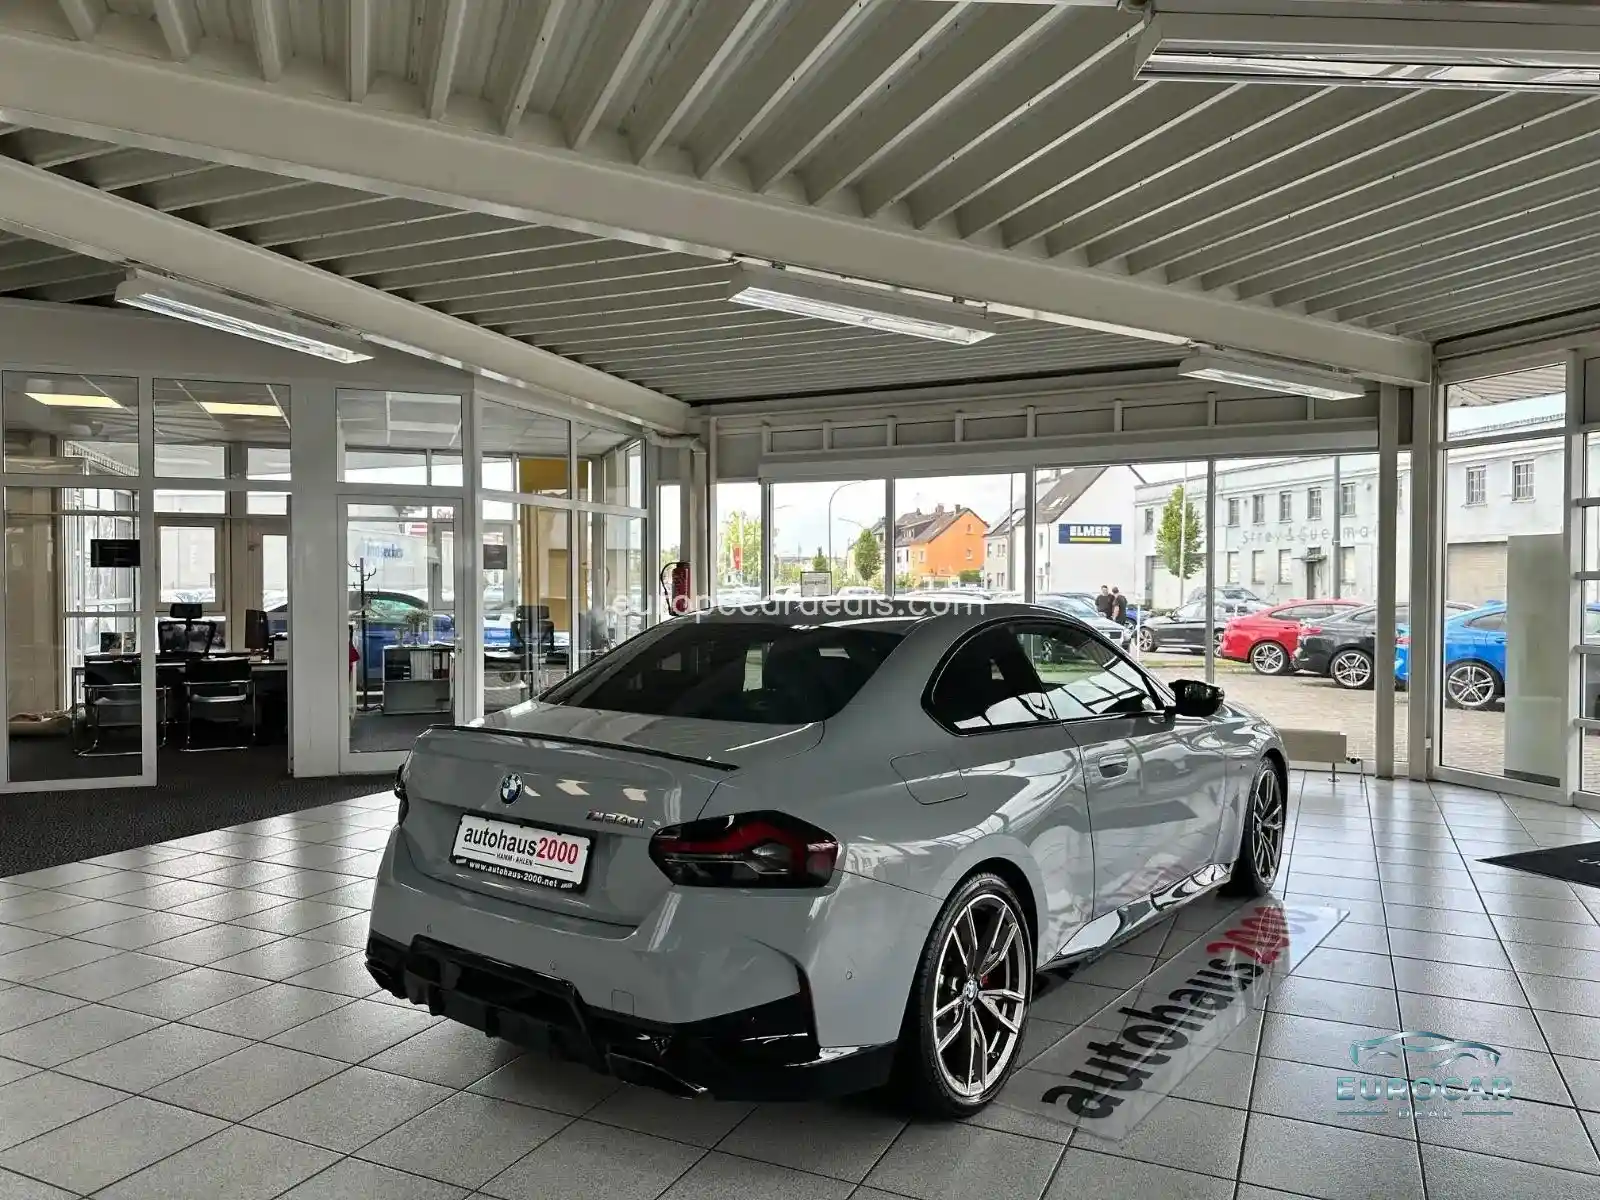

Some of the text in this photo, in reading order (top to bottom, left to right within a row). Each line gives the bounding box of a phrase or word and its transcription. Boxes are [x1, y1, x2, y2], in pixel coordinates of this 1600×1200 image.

[1069, 525, 1111, 537] ELMER
[464, 827, 579, 865] autohaus2000
[469, 861, 557, 888] www.autohaus-2000.net
